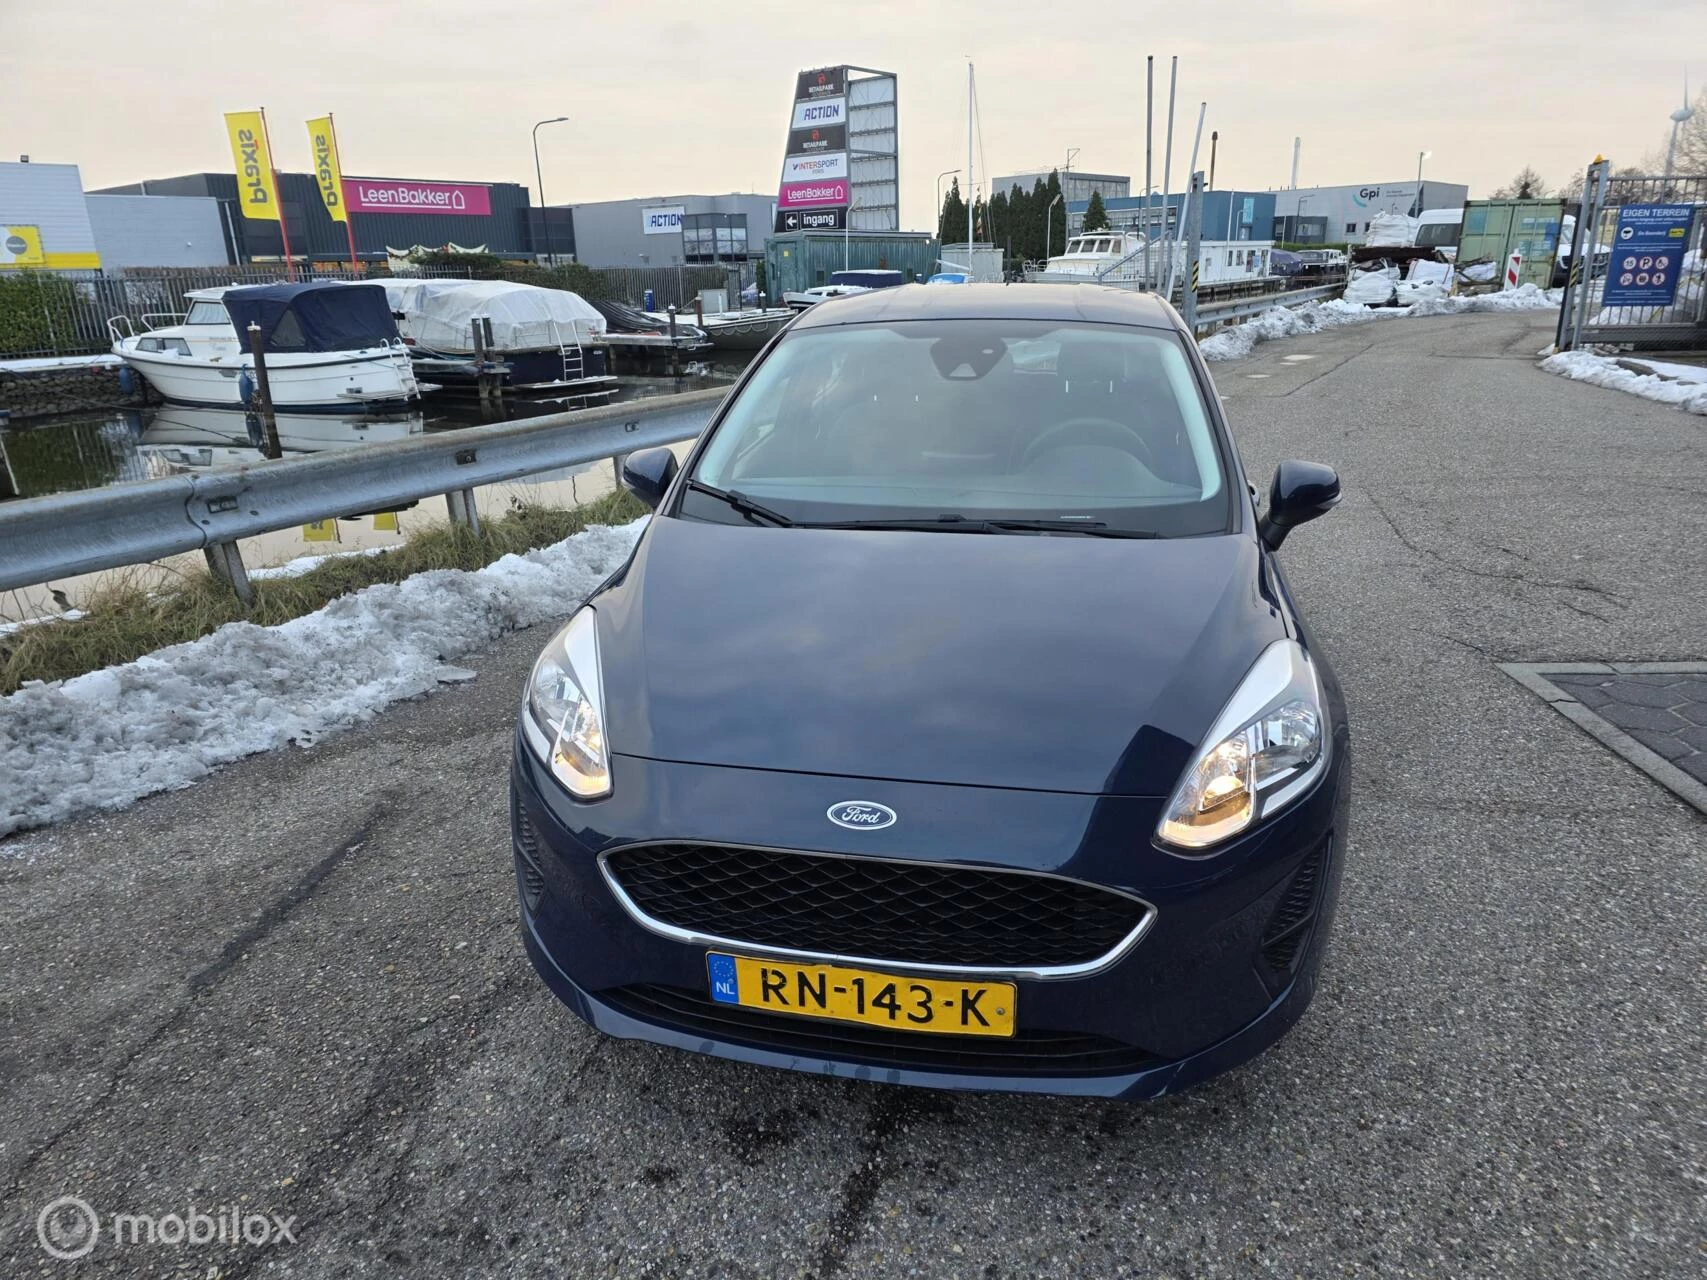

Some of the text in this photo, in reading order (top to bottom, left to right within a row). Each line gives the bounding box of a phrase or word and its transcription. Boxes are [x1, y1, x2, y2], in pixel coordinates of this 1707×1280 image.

[805, 105, 839, 120] ACTION
[798, 158, 838, 170] INTERSPORT
[359, 186, 450, 205] LeenBakker
[787, 188, 835, 200] LeenBakker
[1360, 187, 1380, 200] Gpi
[1622, 208, 1690, 217] EIGEN TERREIN
[803, 214, 835, 227] ingang
[841, 805, 881, 825] Ford
[716, 982, 735, 996] NL
[760, 968, 991, 1027] RN-143-K
